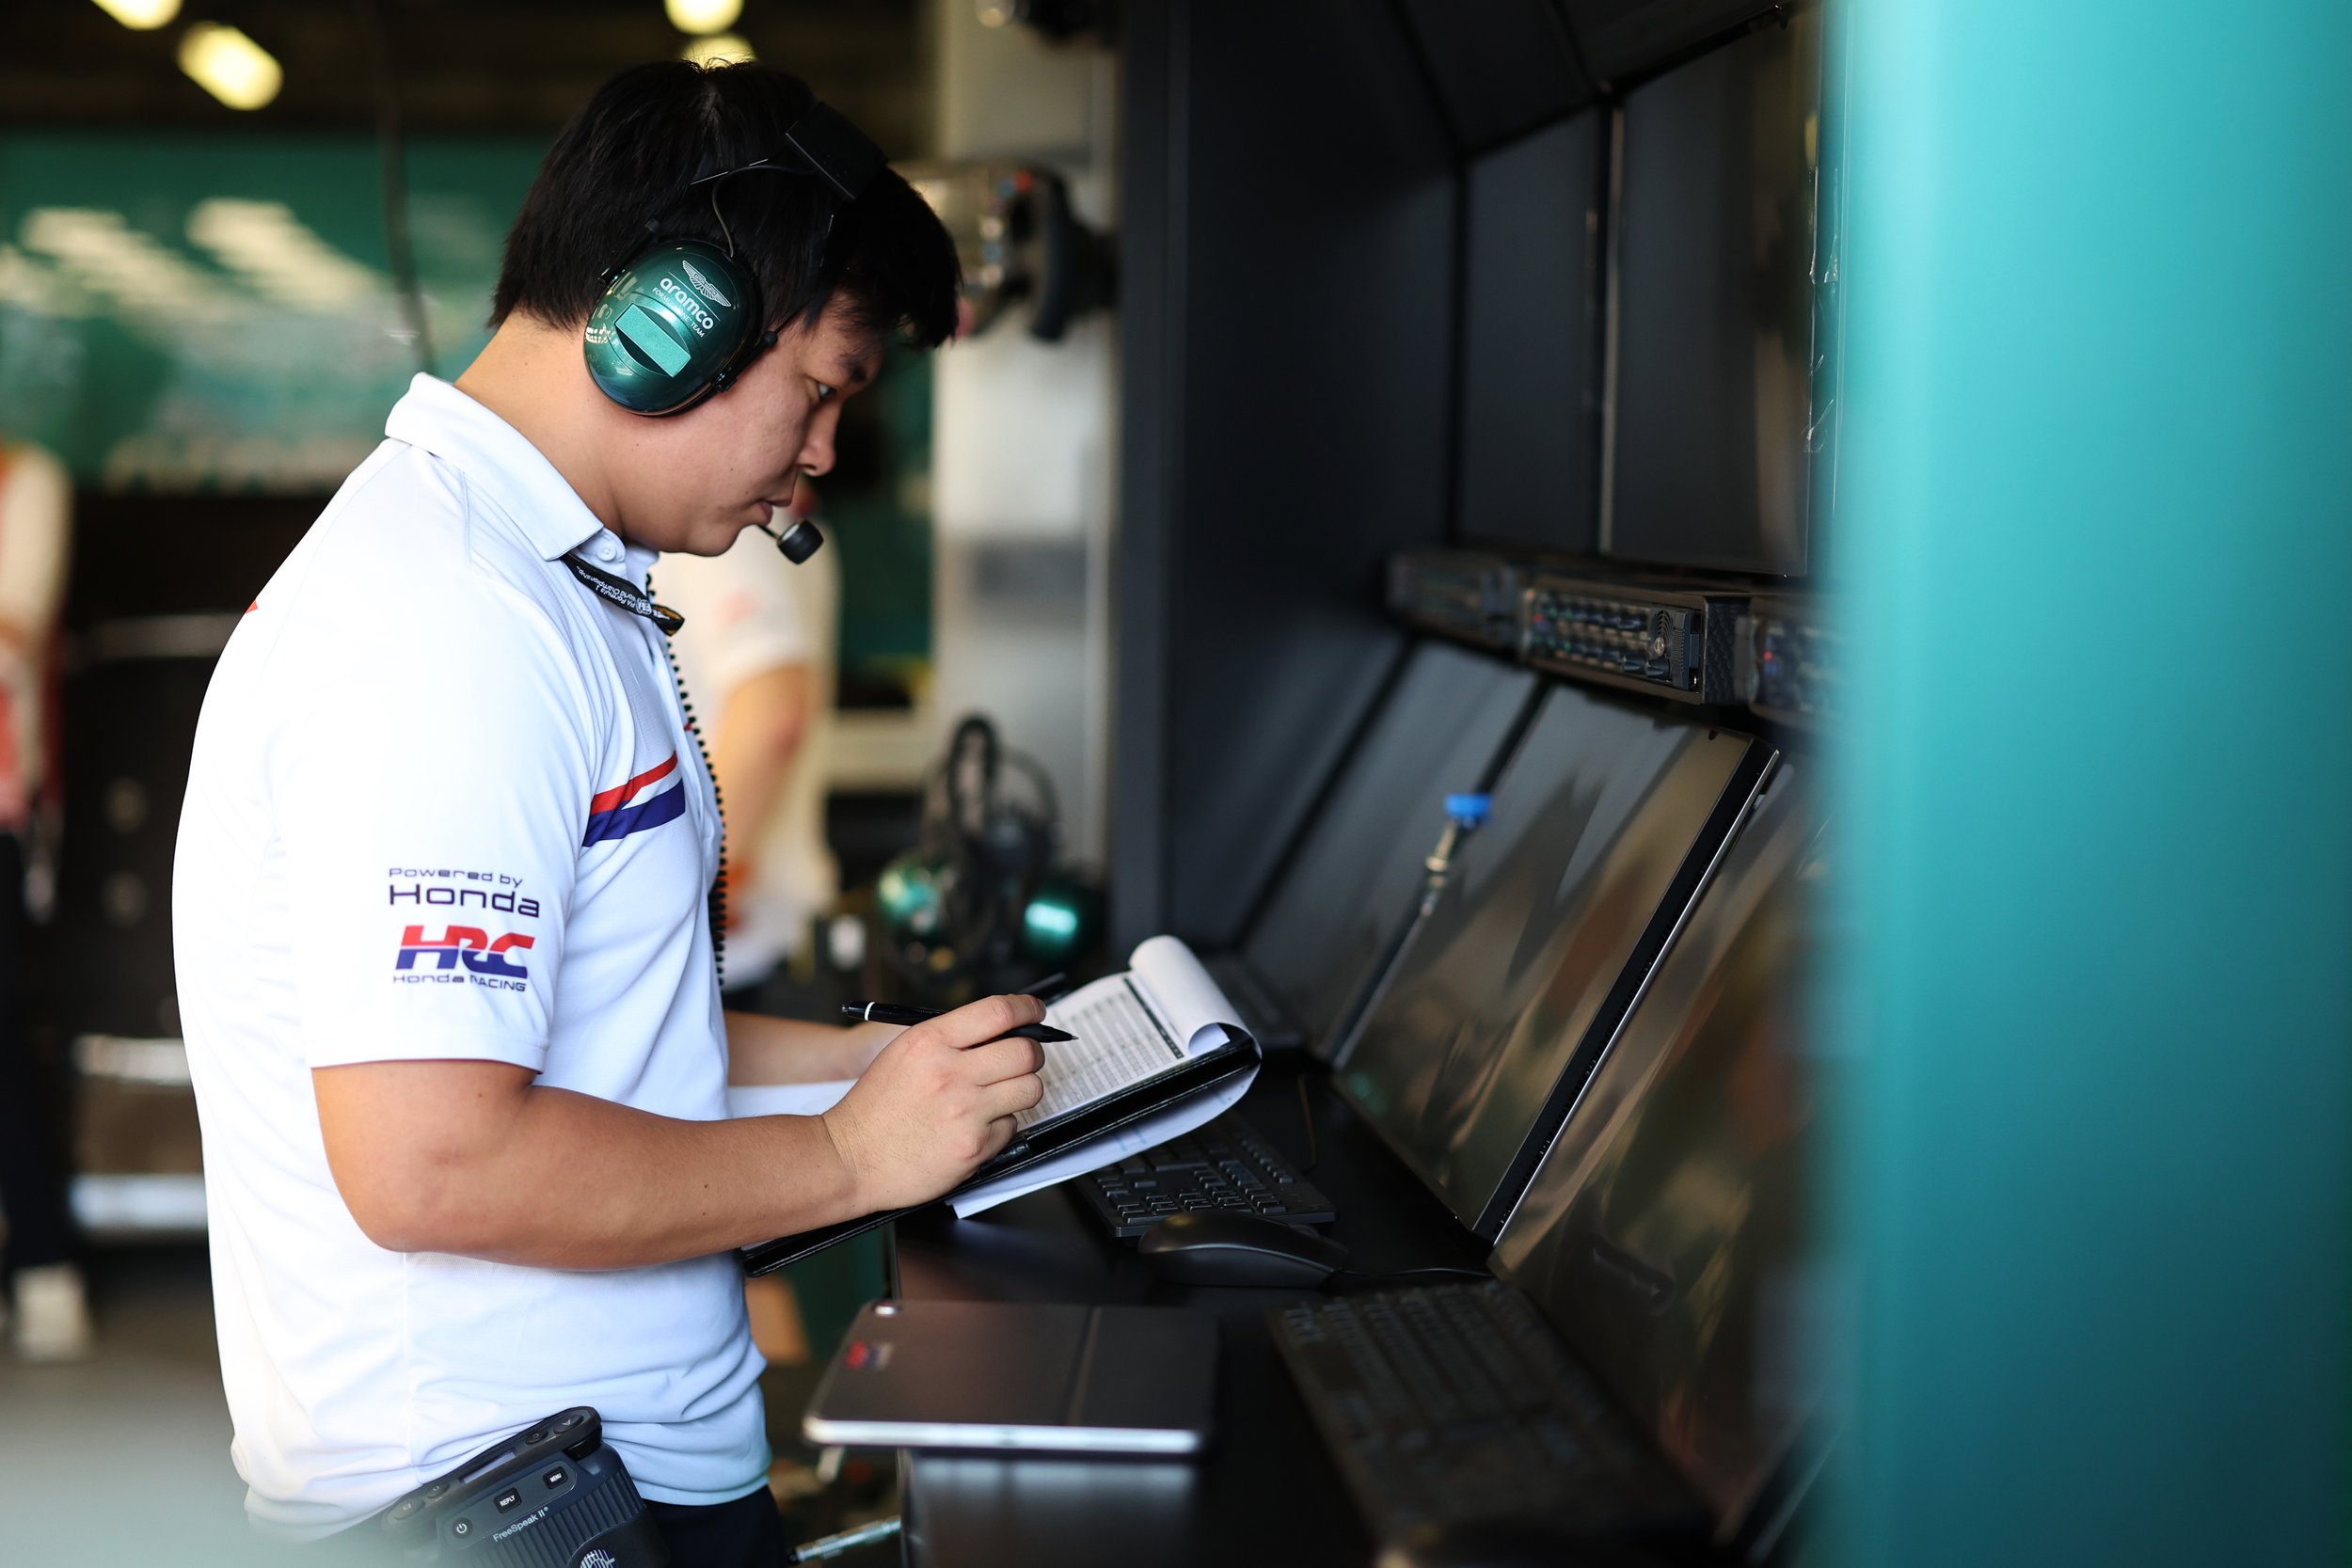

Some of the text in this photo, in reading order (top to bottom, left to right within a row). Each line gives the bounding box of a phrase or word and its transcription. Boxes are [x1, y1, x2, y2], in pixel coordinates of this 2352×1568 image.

[660, 277, 714, 329] aramco
[691, 321, 705, 338] TEAM
[600, 588, 628, 605] Formula
[389, 867, 523, 888] Powered by
[389, 883, 540, 918] Honda
[395, 924, 535, 979] HRC
[393, 974, 527, 992] Honda RACING
[549, 1473, 563, 1482] MENU
[500, 1495, 516, 1507] REPLY
[492, 1513, 539, 1542] FreeSpeak
